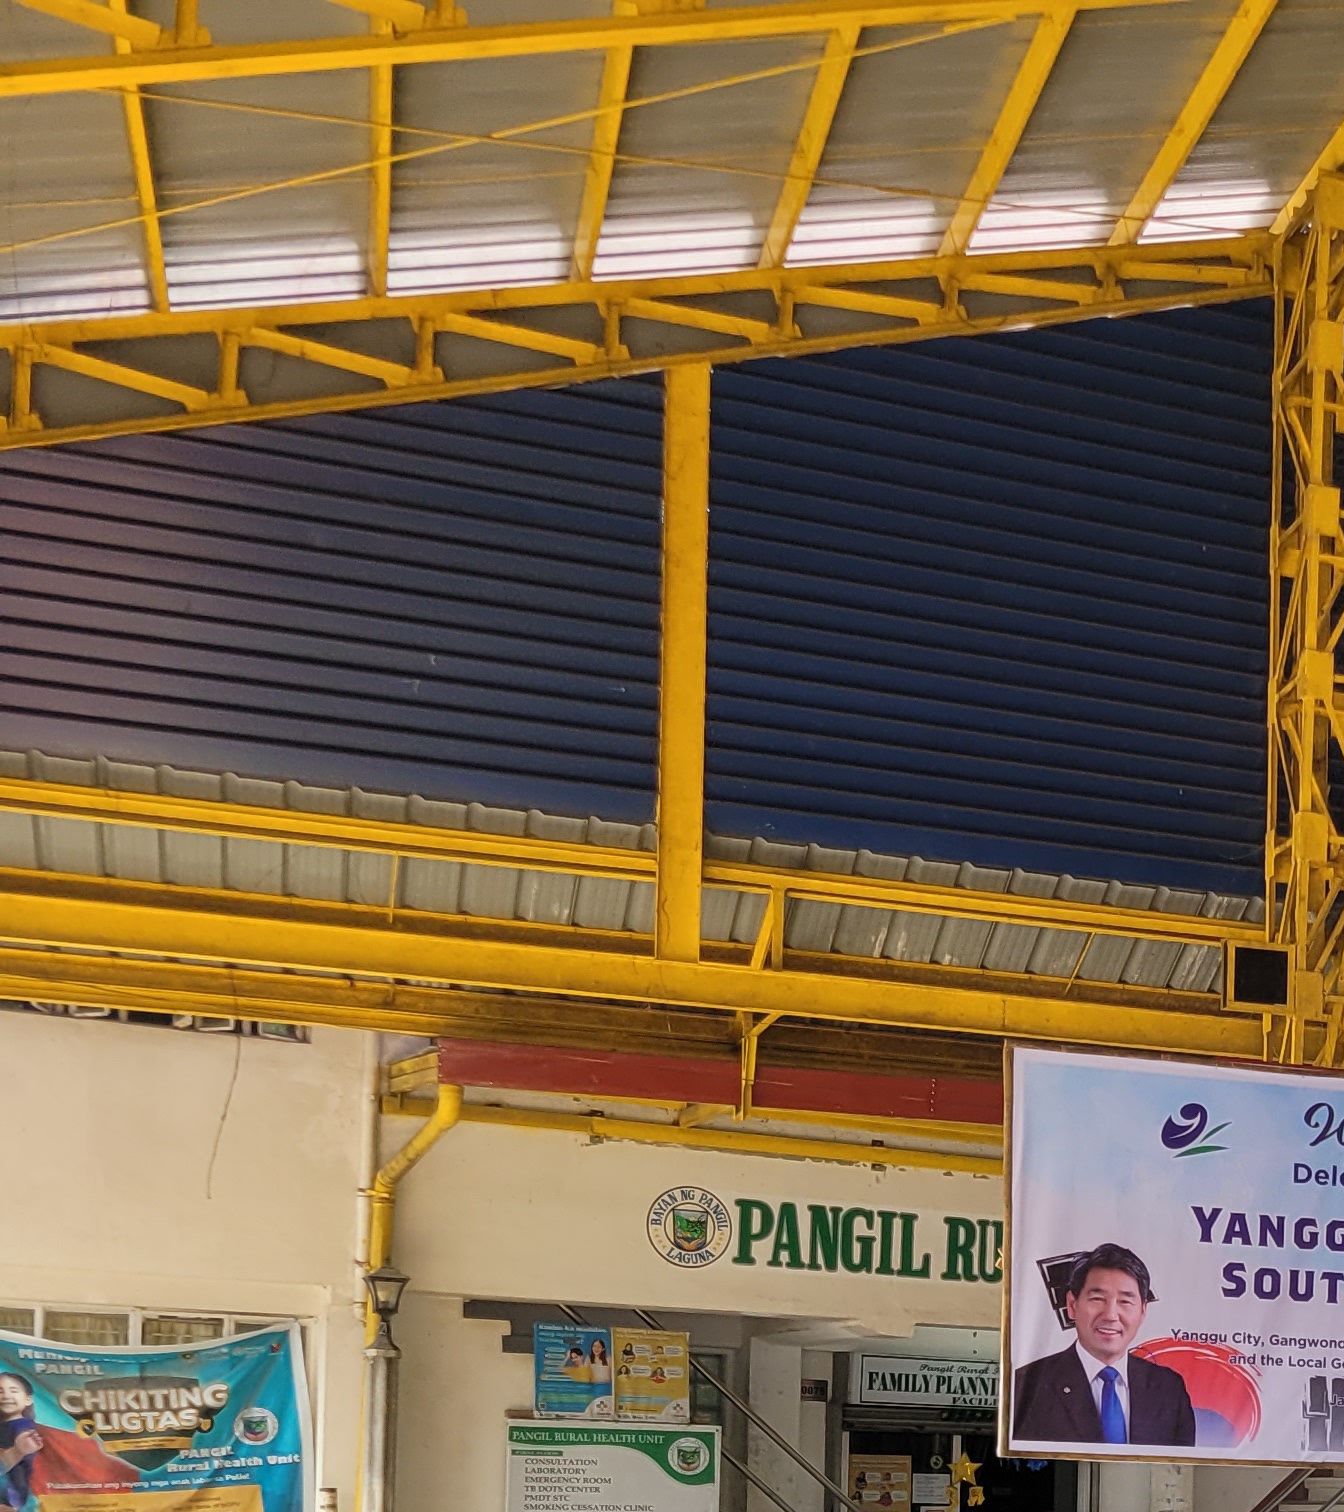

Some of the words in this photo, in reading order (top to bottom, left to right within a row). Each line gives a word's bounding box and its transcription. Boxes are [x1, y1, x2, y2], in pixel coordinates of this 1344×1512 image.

[650, 1191, 679, 1227] BAYAN
[679, 1189, 696, 1202] NG
[698, 1192, 729, 1232] PANGIL
[732, 1198, 932, 1280] PANGIL
[941, 1215, 1003, 1284] RU
[665, 1246, 716, 1265] LAGUNA
[1171, 1328, 1228, 1345] Yanggu
[1231, 1331, 1266, 1348] City,
[1229, 1353, 1256, 1366] and
[1260, 1354, 1284, 1367] the
[1288, 1356, 1327, 1370] Local
[867, 1370, 932, 1393] FAMILY
[935, 1374, 1000, 1397] PLANNI
[952, 1396, 998, 1407] FACILI
[92, 1409, 202, 1433] LIGTAS
[512, 1431, 552, 1441] PANGIL
[554, 1432, 591, 1442] RURAL
[593, 1433, 636, 1444] HEALTH
[638, 1434, 665, 1445] UNIT
[179, 1446, 235, 1460] PANGIL
[166, 1460, 211, 1473] Rural
[213, 1456, 263, 1472] Health
[266, 1453, 302, 1467] Unit
[525, 1458, 598, 1466] CONSULTATION
[525, 1467, 587, 1475] LABORATORY
[525, 1476, 582, 1484] EMERGENCY
[583, 1477, 612, 1485] ROOM
[525, 1485, 537, 1493] TB
[539, 1485, 564, 1493] DOTS
[524, 1494, 552, 1502] PMDT
[553, 1494, 571, 1502] STC
[523, 1503, 570, 1511] SMOKING
[571, 1504, 623, 1512] CESSATION
[623, 1504, 655, 1512] CLINIC
